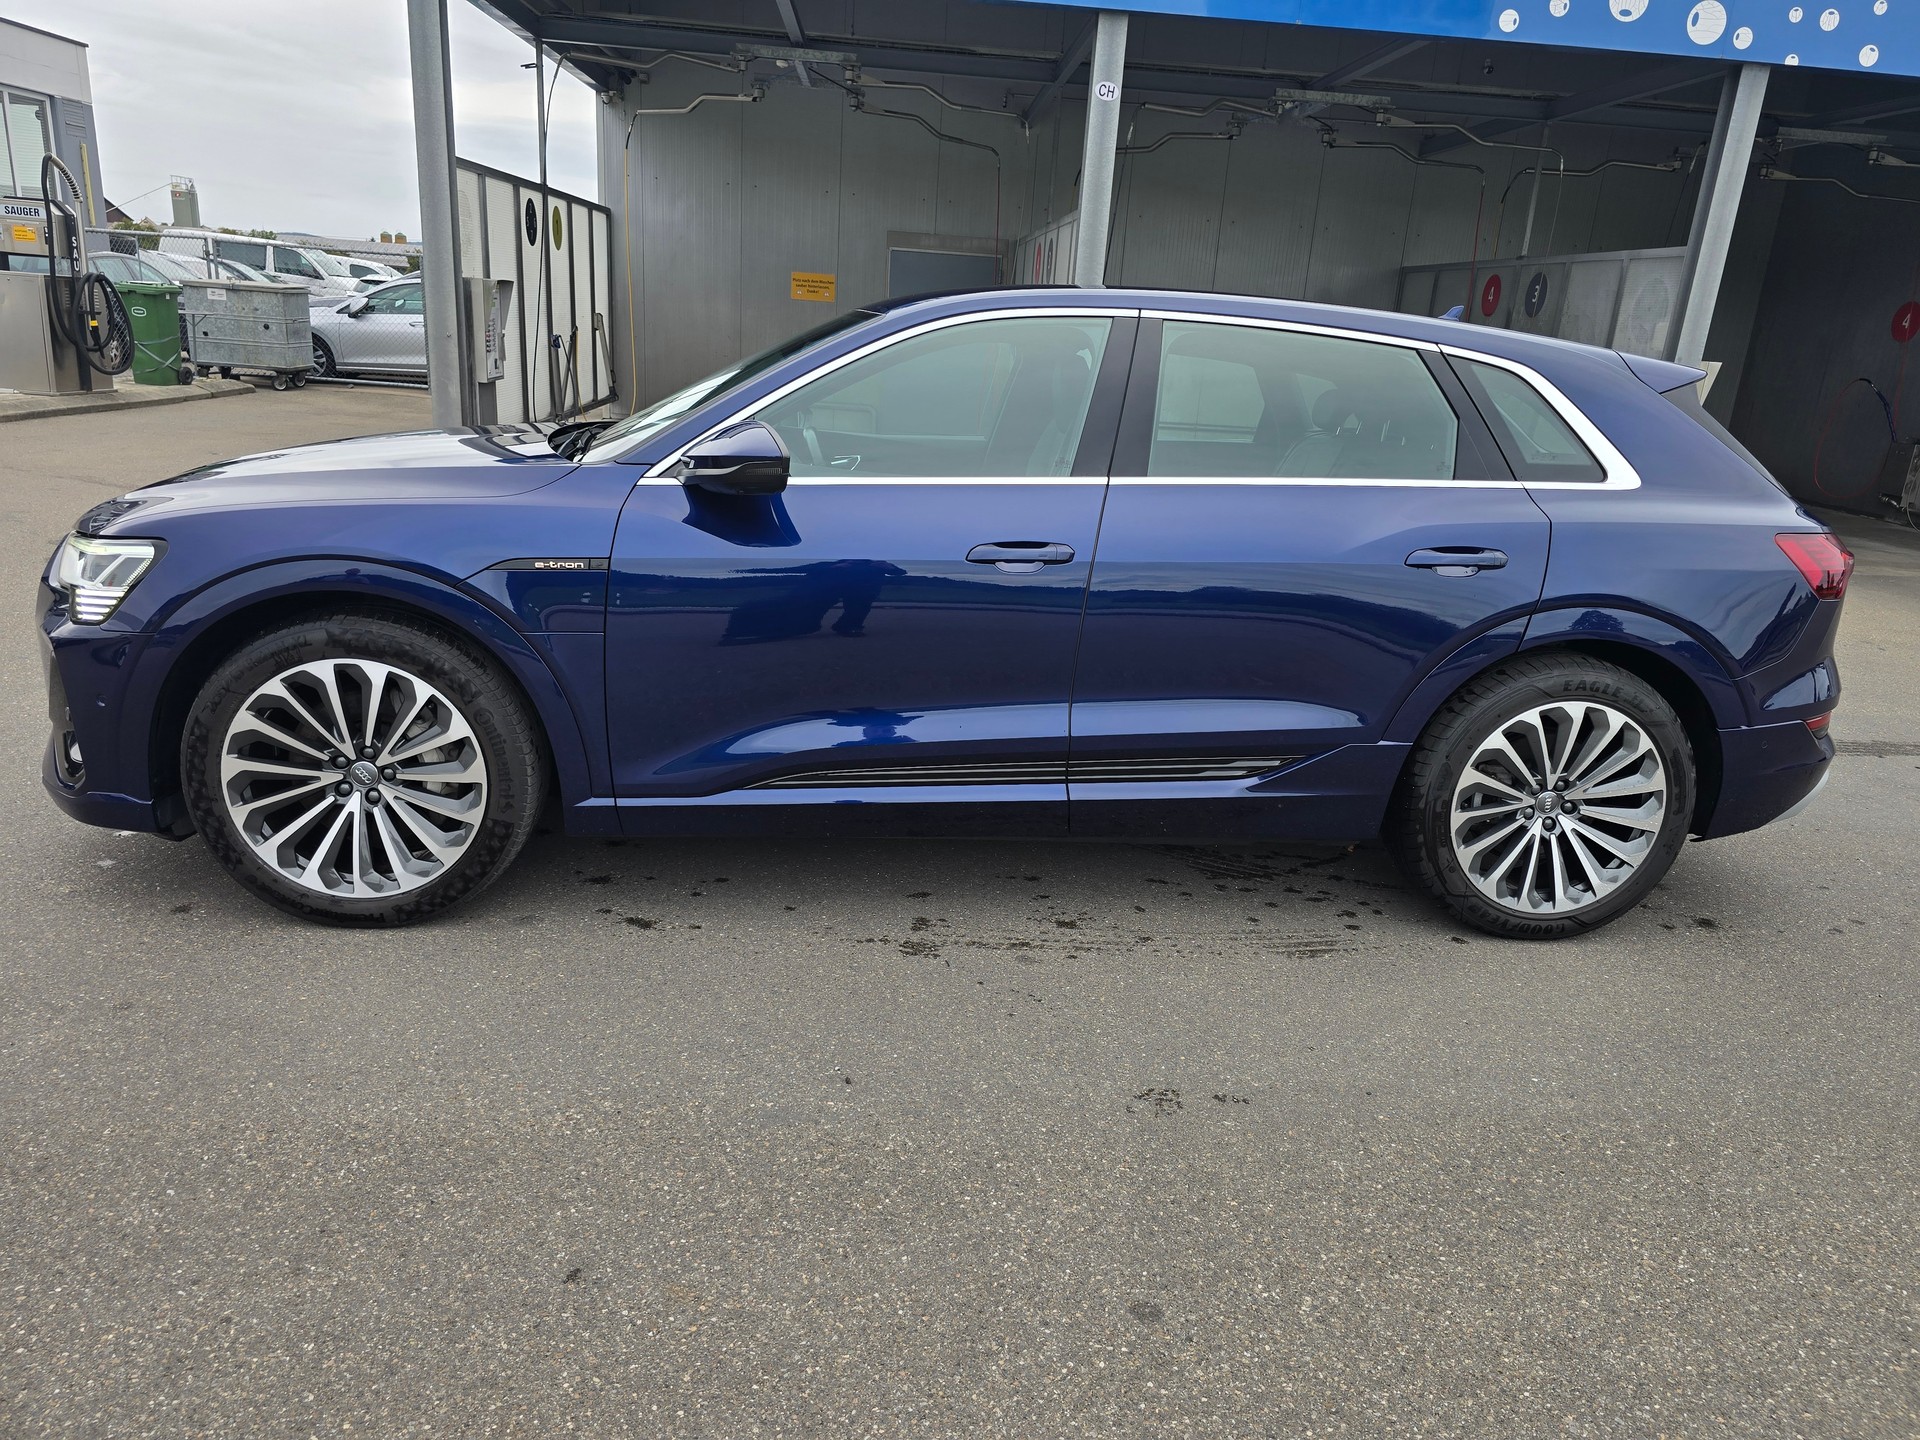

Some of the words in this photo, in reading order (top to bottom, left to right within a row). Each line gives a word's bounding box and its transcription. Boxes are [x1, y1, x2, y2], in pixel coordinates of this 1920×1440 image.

[1098, 84, 1116, 99] CH
[4, 205, 40, 217] SAUGER
[1488, 286, 1494, 303] 4
[1532, 285, 1540, 302] 3
[1902, 313, 1911, 329] 4
[534, 561, 584, 569] e-tron
[1563, 679, 1624, 698] EAGLE
[473, 707, 515, 800] Continental
